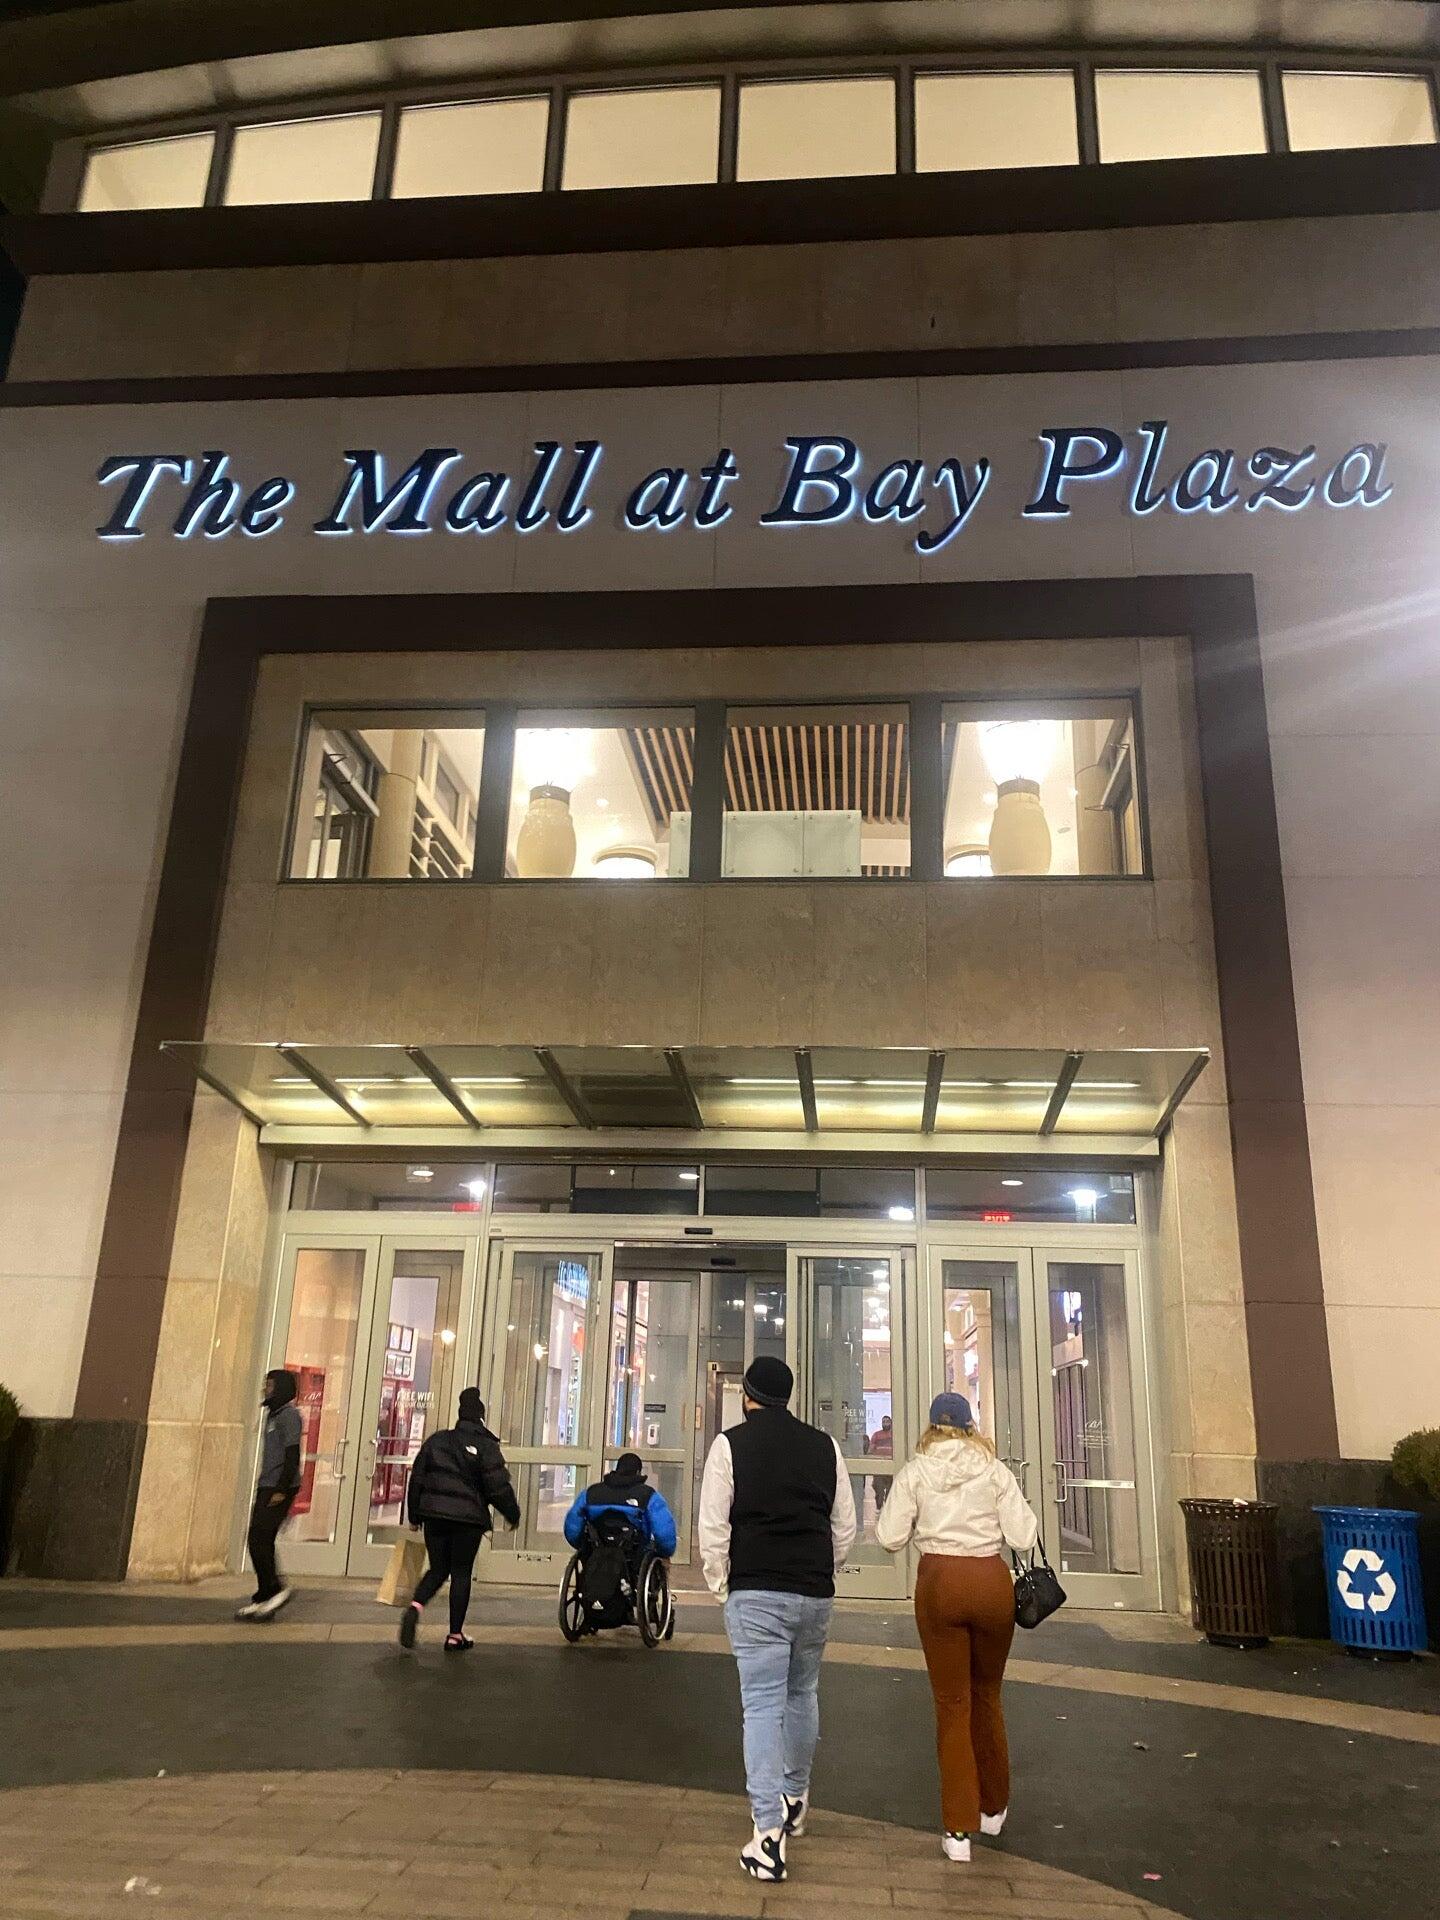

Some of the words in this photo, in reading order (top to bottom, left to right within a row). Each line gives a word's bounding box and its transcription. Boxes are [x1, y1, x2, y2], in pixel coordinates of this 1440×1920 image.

[95, 449, 295, 540] The
[313, 439, 602, 536] Mall
[625, 446, 740, 530] at
[759, 435, 991, 554] Bay
[1021, 419, 1395, 519] Plaza
[417, 1391, 435, 1402] WIFI
